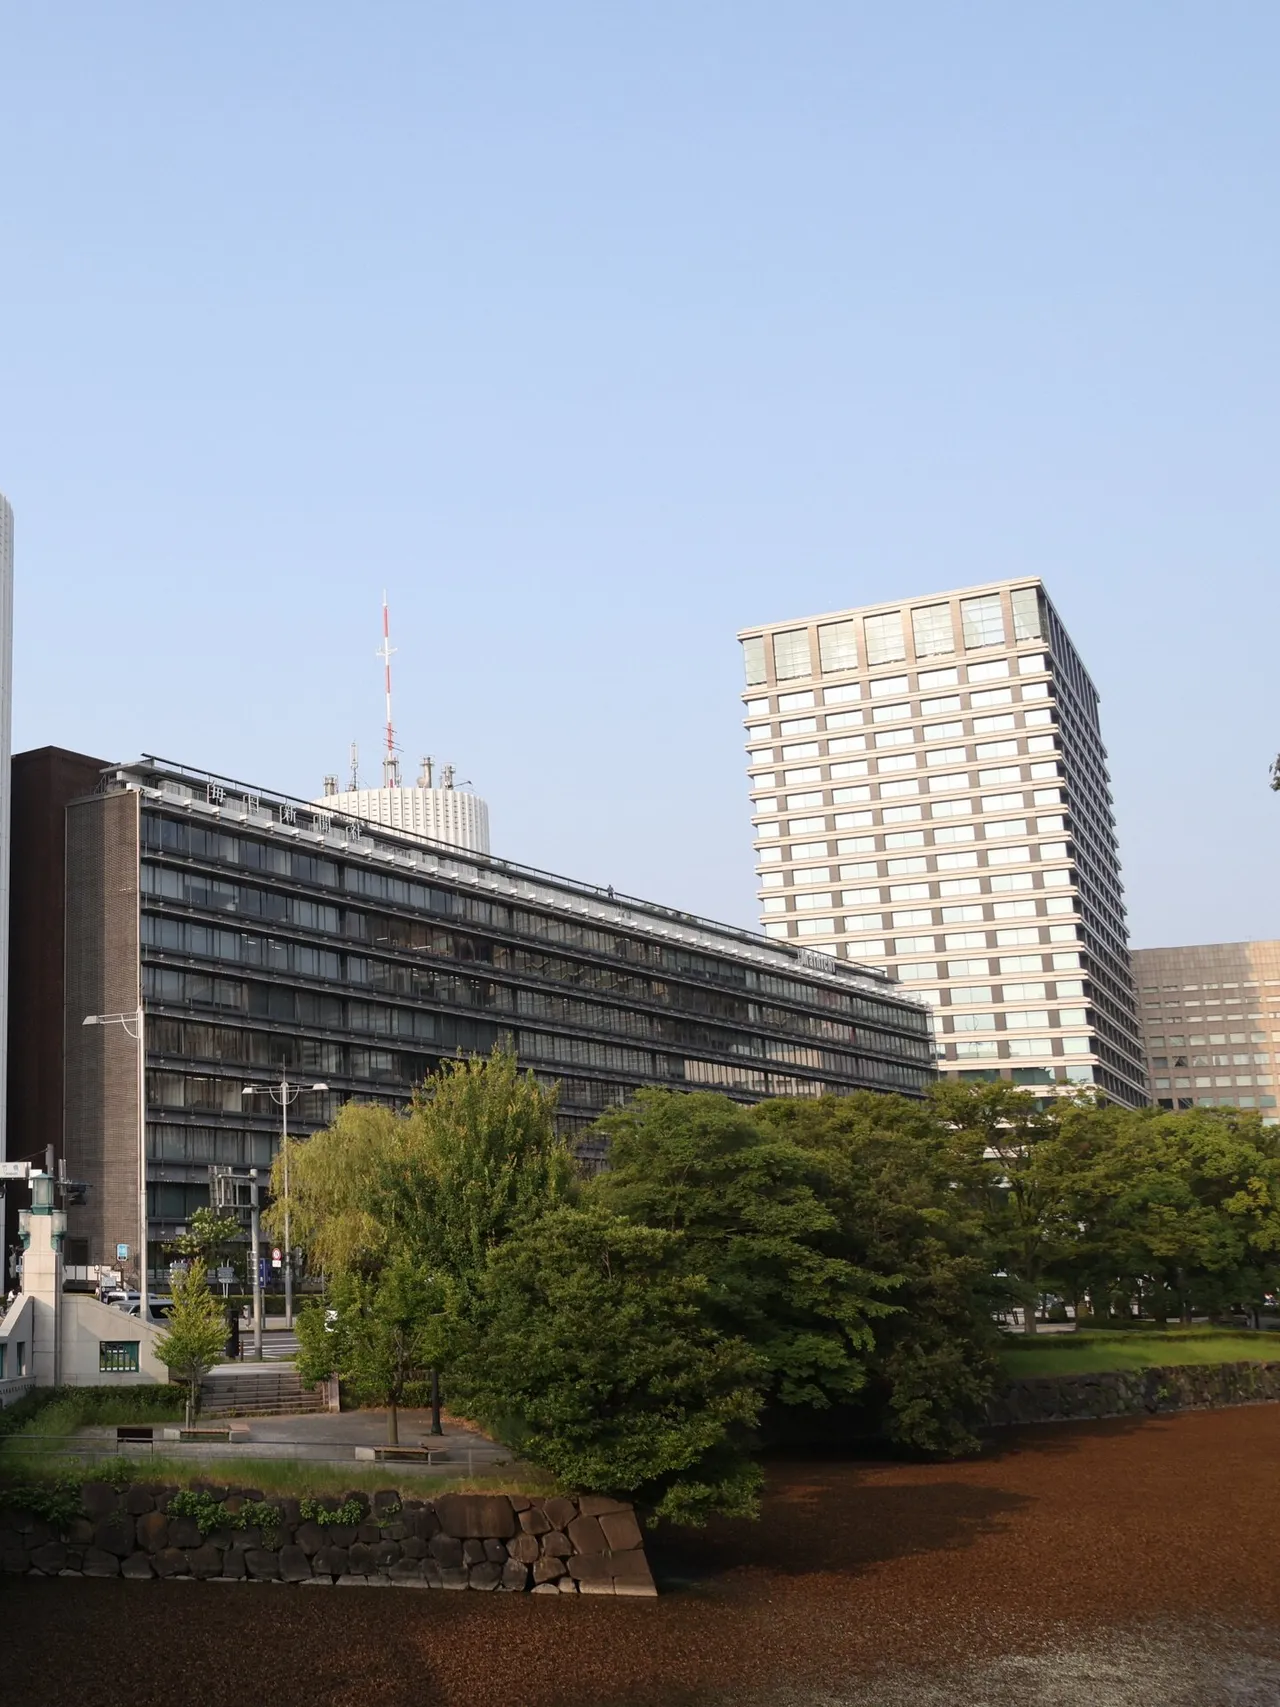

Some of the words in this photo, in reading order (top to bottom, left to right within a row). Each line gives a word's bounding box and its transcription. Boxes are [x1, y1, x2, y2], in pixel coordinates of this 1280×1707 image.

[209, 781, 362, 841] 毎日新聞社
